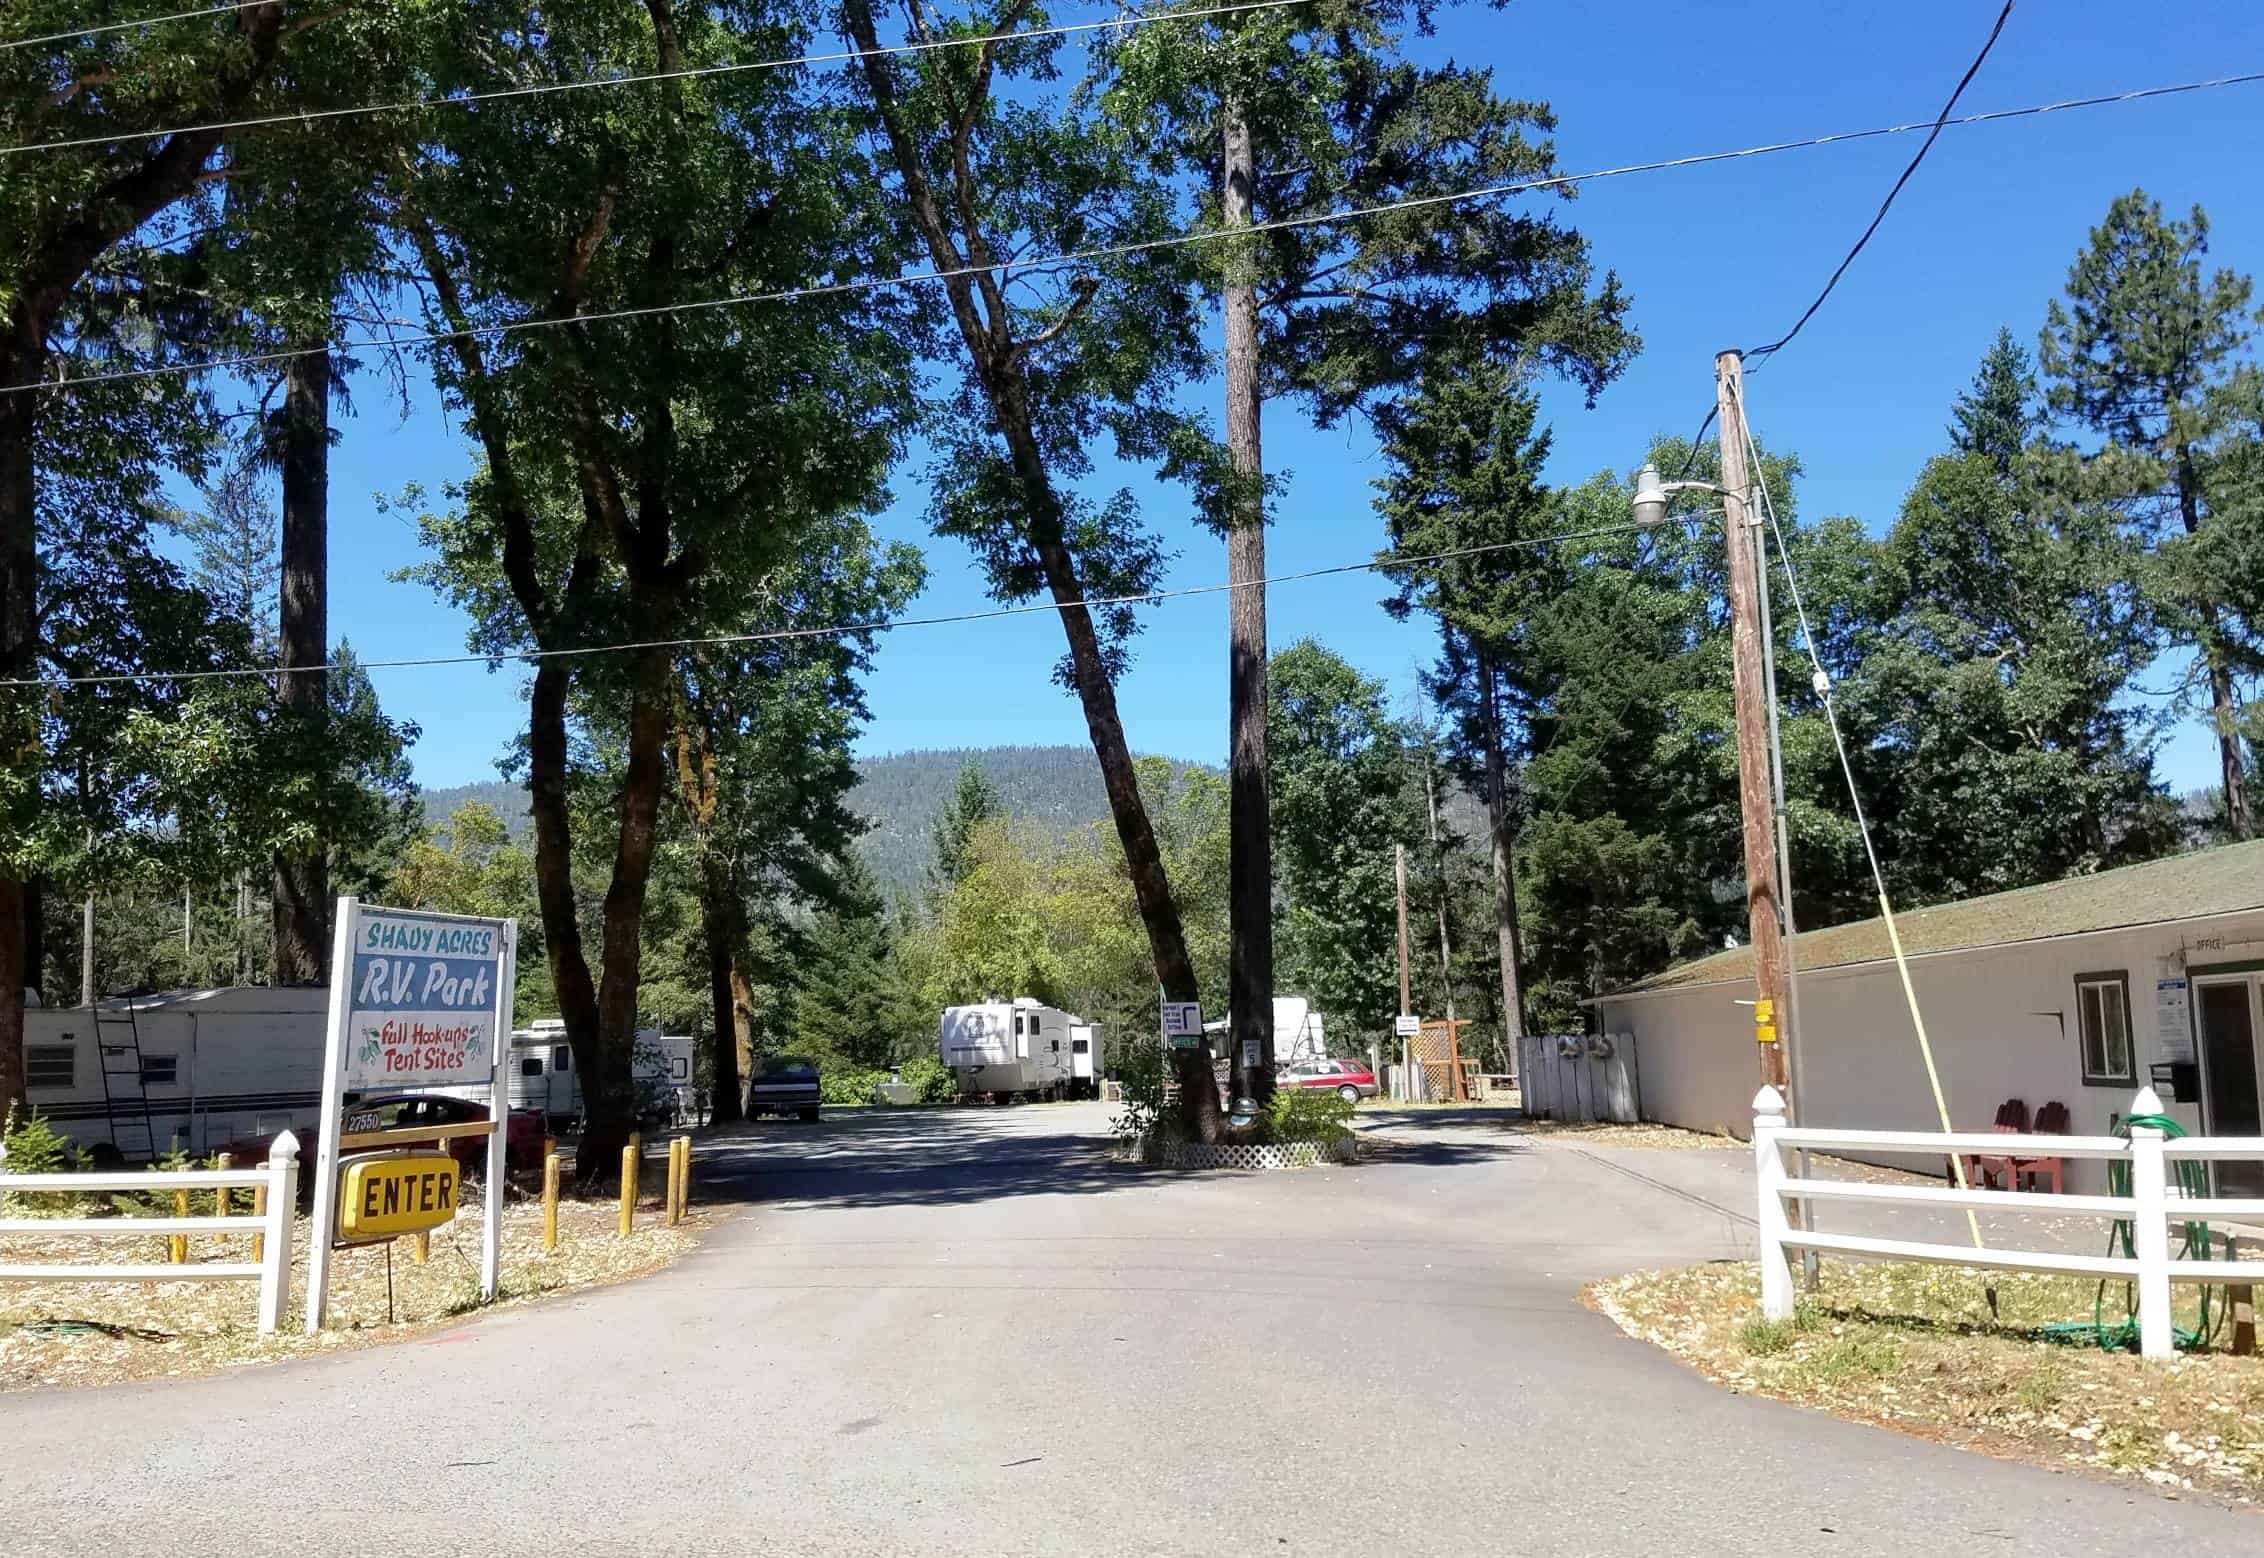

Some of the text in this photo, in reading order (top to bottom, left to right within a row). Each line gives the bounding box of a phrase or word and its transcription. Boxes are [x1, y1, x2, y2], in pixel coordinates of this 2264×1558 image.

[366, 922, 492, 955] SHADY ACRES
[358, 958, 489, 1006] R.V. Park
[381, 1020, 408, 1045] Full
[384, 1047, 465, 1072] Tent Sites
[348, 1113, 379, 1132] 27550
[364, 1172, 453, 1218] ENTER
